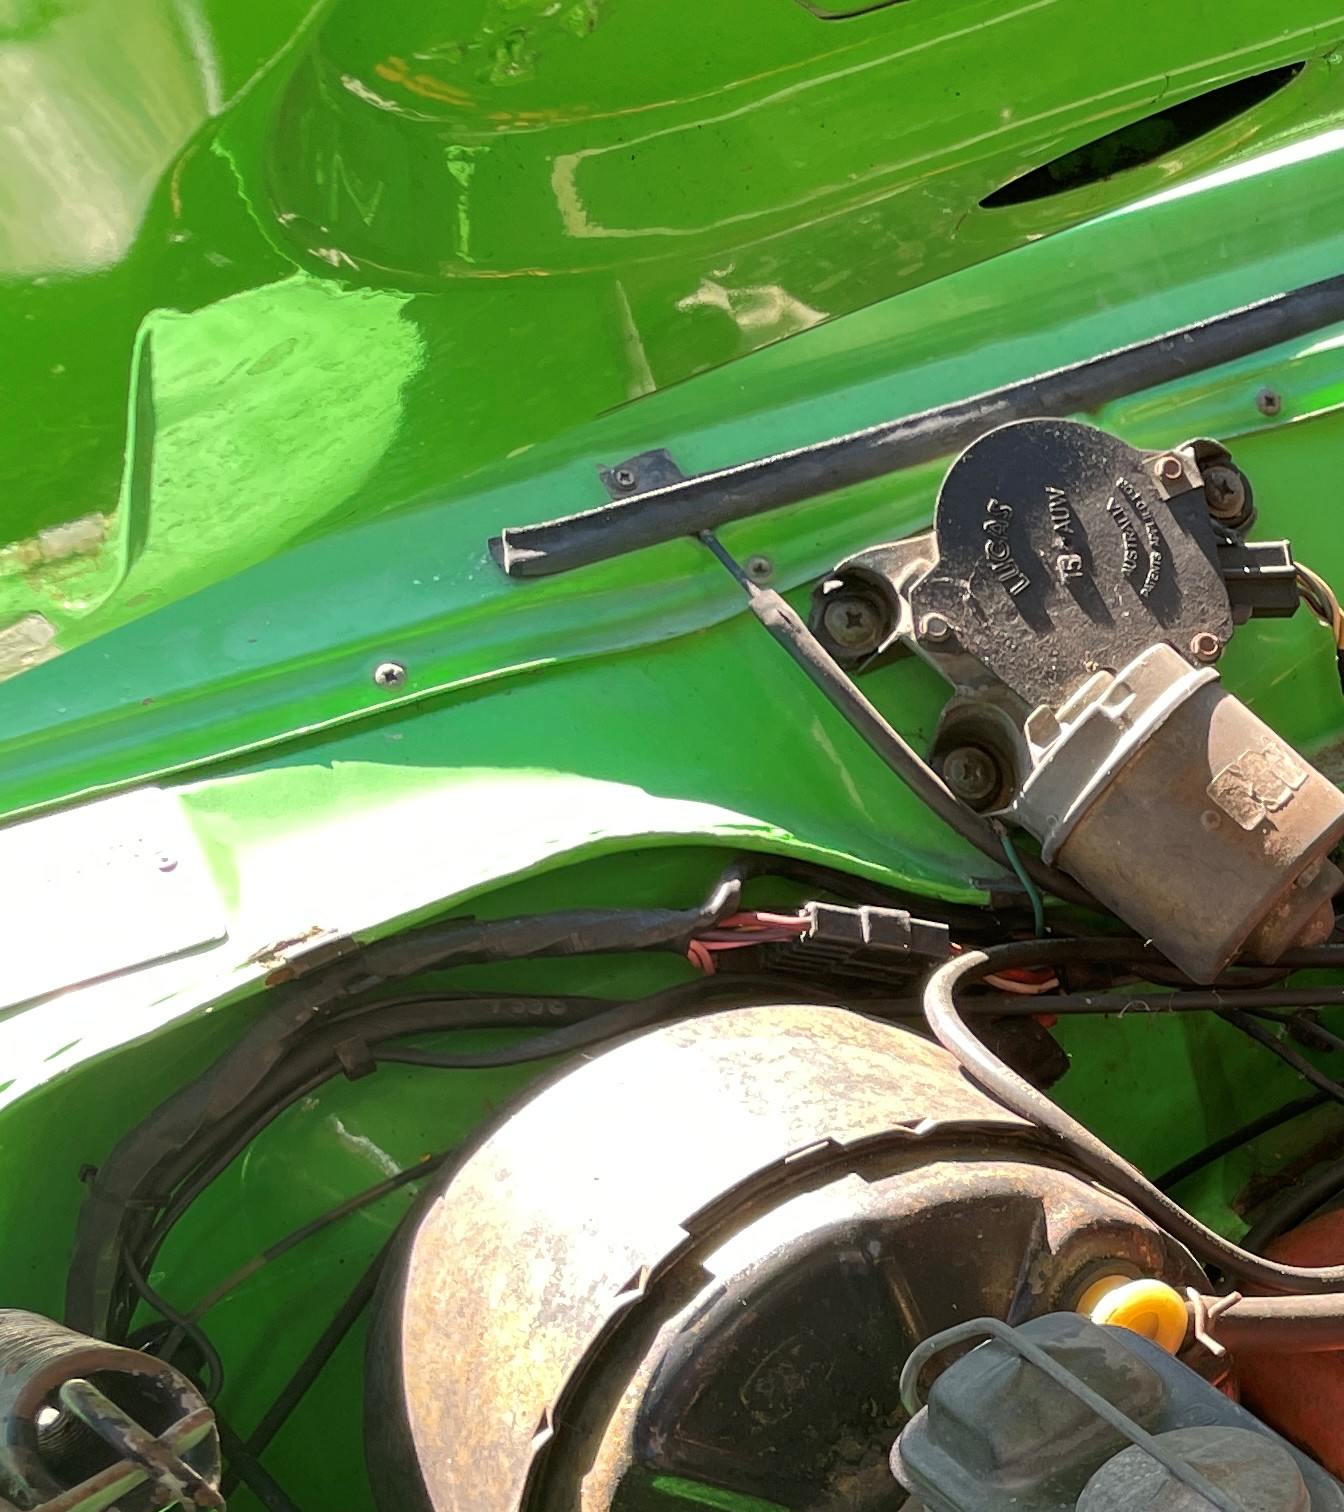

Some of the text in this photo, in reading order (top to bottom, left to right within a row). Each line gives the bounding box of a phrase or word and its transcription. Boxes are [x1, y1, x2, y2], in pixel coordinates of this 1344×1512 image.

[983, 498, 1031, 596] LUCAS
[1107, 496, 1138, 577] AUSTRALIA
[1140, 551, 1162, 598] PATENTS
